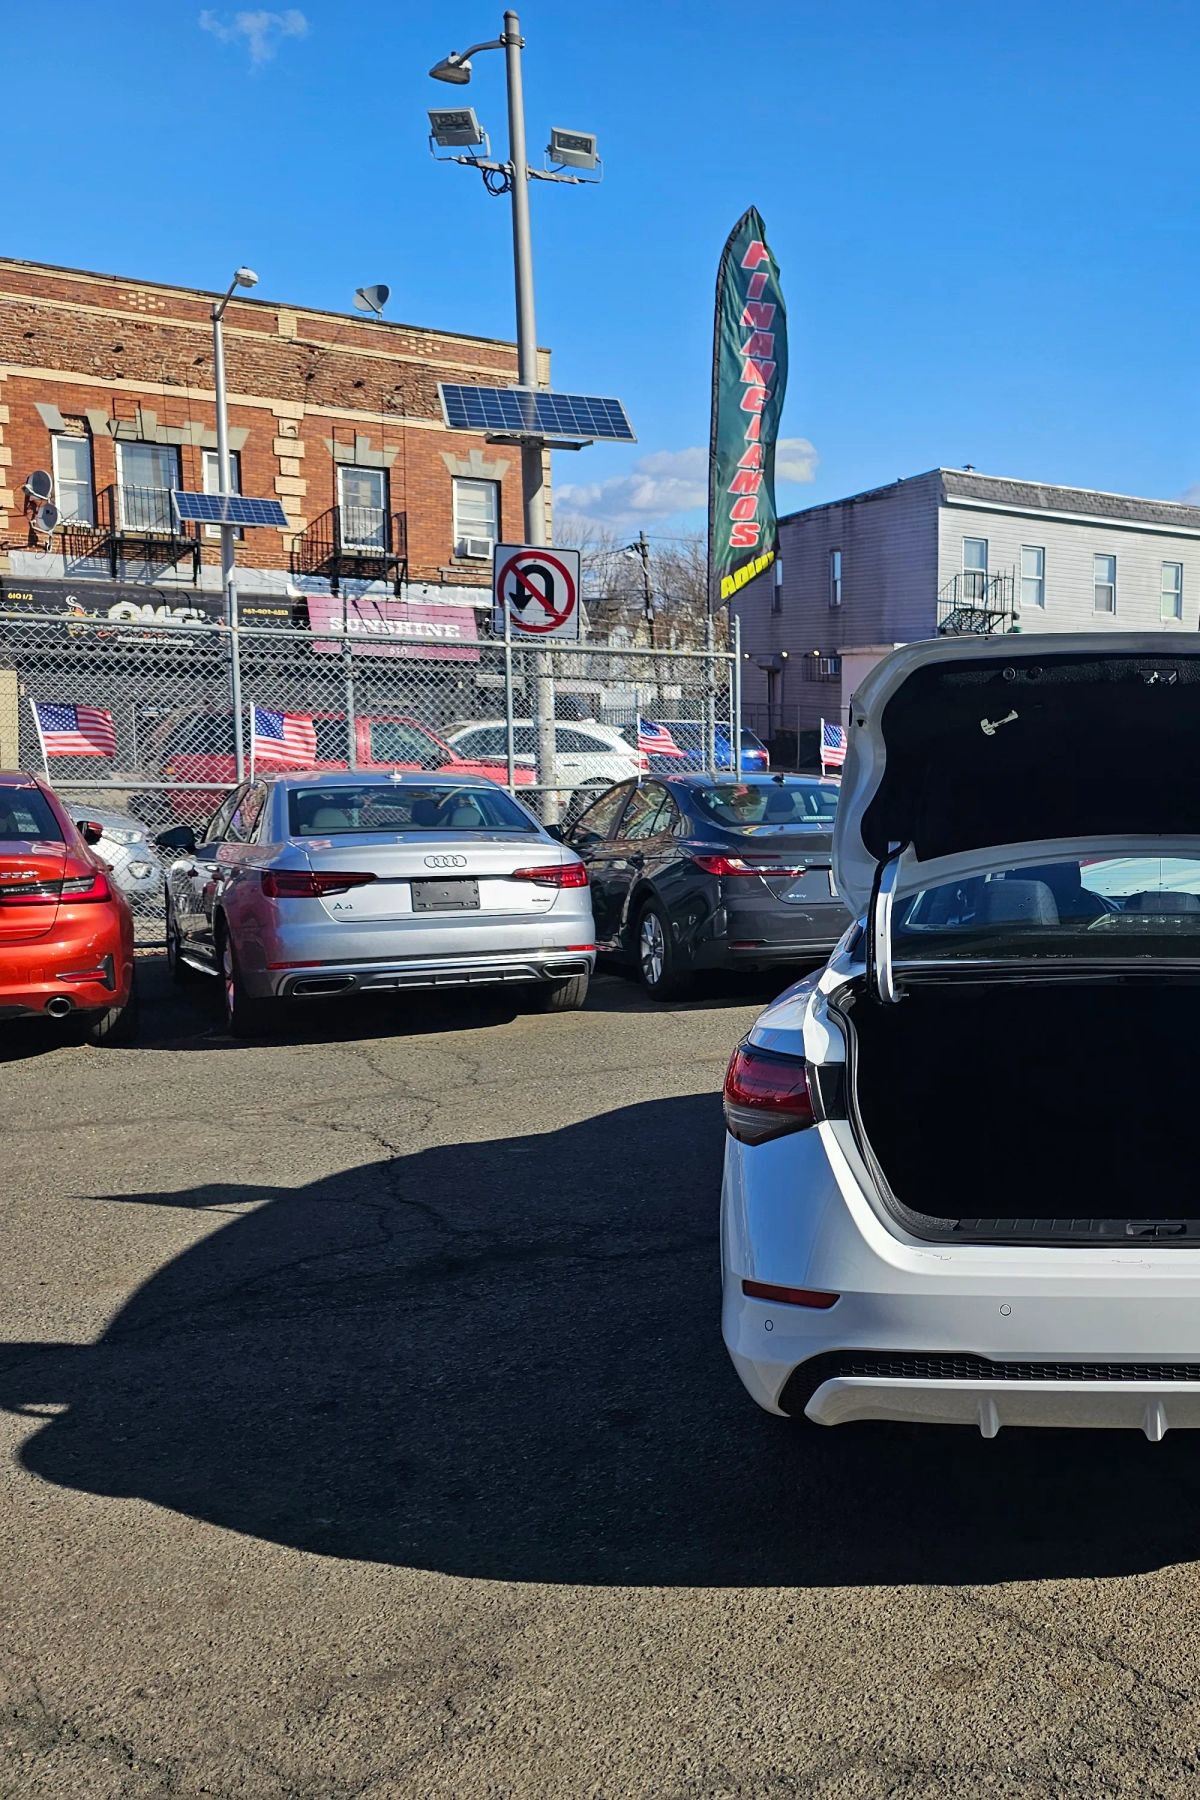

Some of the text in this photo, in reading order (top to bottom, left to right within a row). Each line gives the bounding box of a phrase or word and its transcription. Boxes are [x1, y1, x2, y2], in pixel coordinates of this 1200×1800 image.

[728, 240, 776, 549] FINANCIAMOS
[7, 592, 22, 600] 610
[328, 617, 461, 639] SUNSHINE
[333, 902, 353, 911] A4
